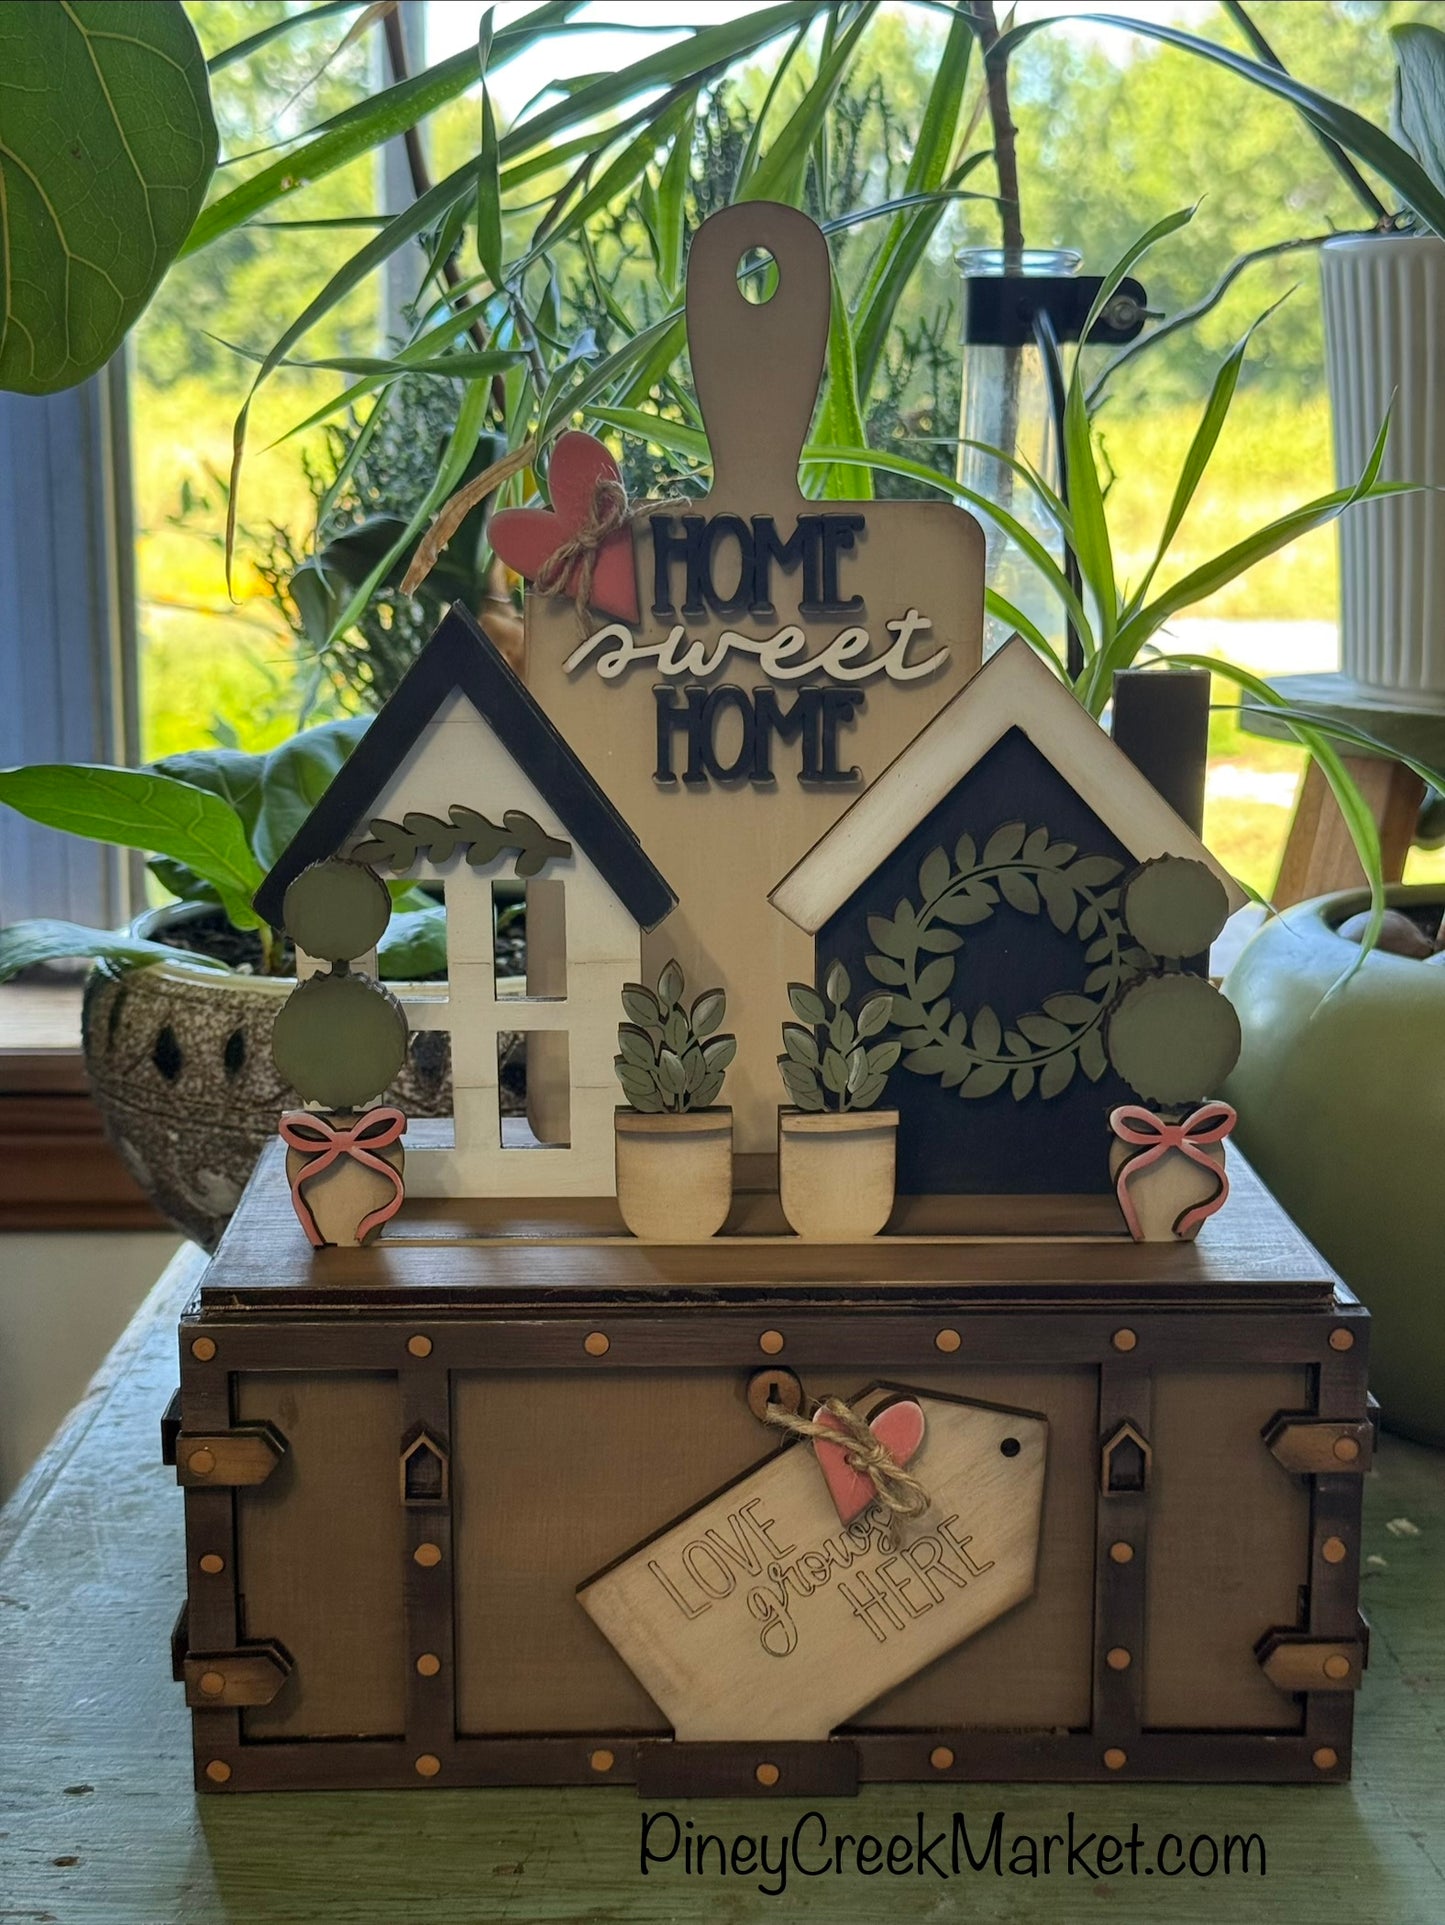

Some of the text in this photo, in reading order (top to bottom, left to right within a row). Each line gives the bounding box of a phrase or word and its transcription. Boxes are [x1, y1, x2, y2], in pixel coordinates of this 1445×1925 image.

[650, 512, 865, 617] HOME
[562, 607, 951, 681] sweet
[651, 684, 865, 785] HOME
[647, 1497, 797, 1620] LOVE
[746, 1505, 899, 1657] grows
[837, 1514, 996, 1643] HERE
